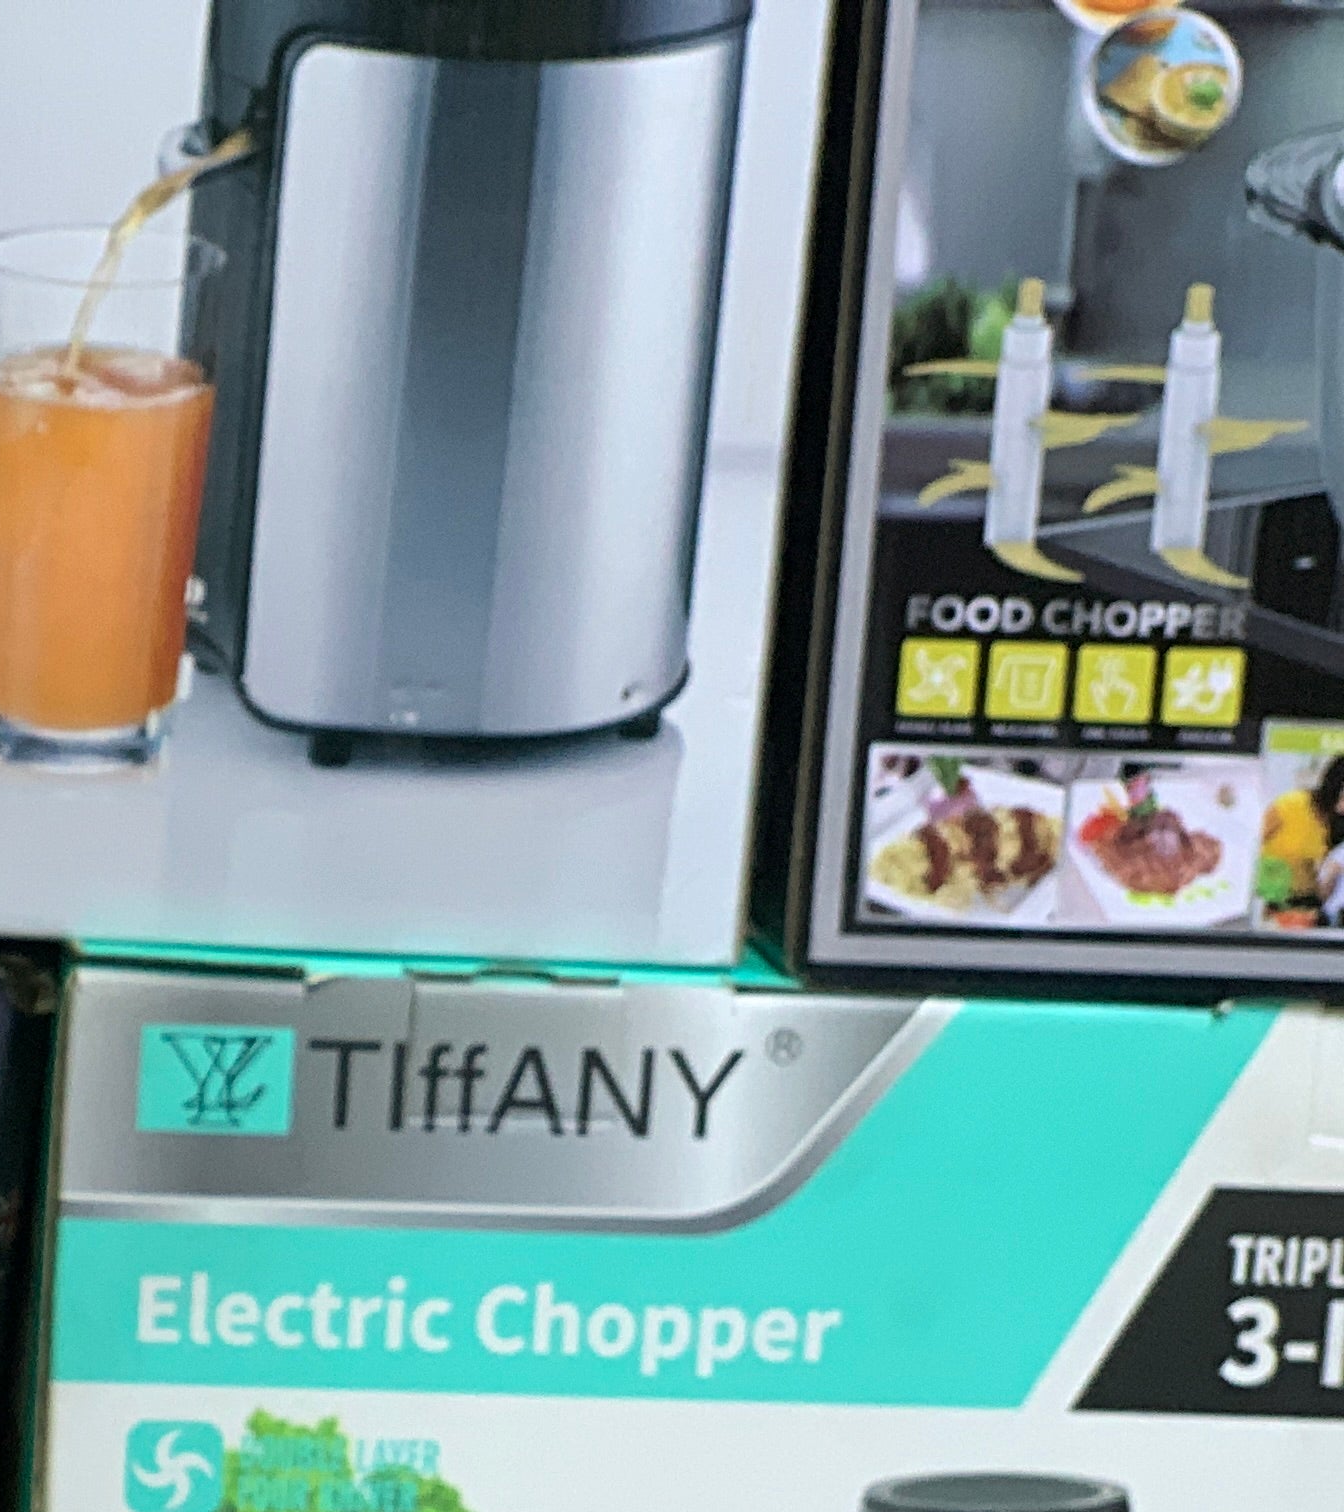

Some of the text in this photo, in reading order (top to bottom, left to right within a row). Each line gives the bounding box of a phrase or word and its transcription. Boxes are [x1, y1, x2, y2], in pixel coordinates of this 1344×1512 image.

[907, 593, 1248, 641] FOOD CHOPPER
[135, 1272, 843, 1379] Electric Chopper
